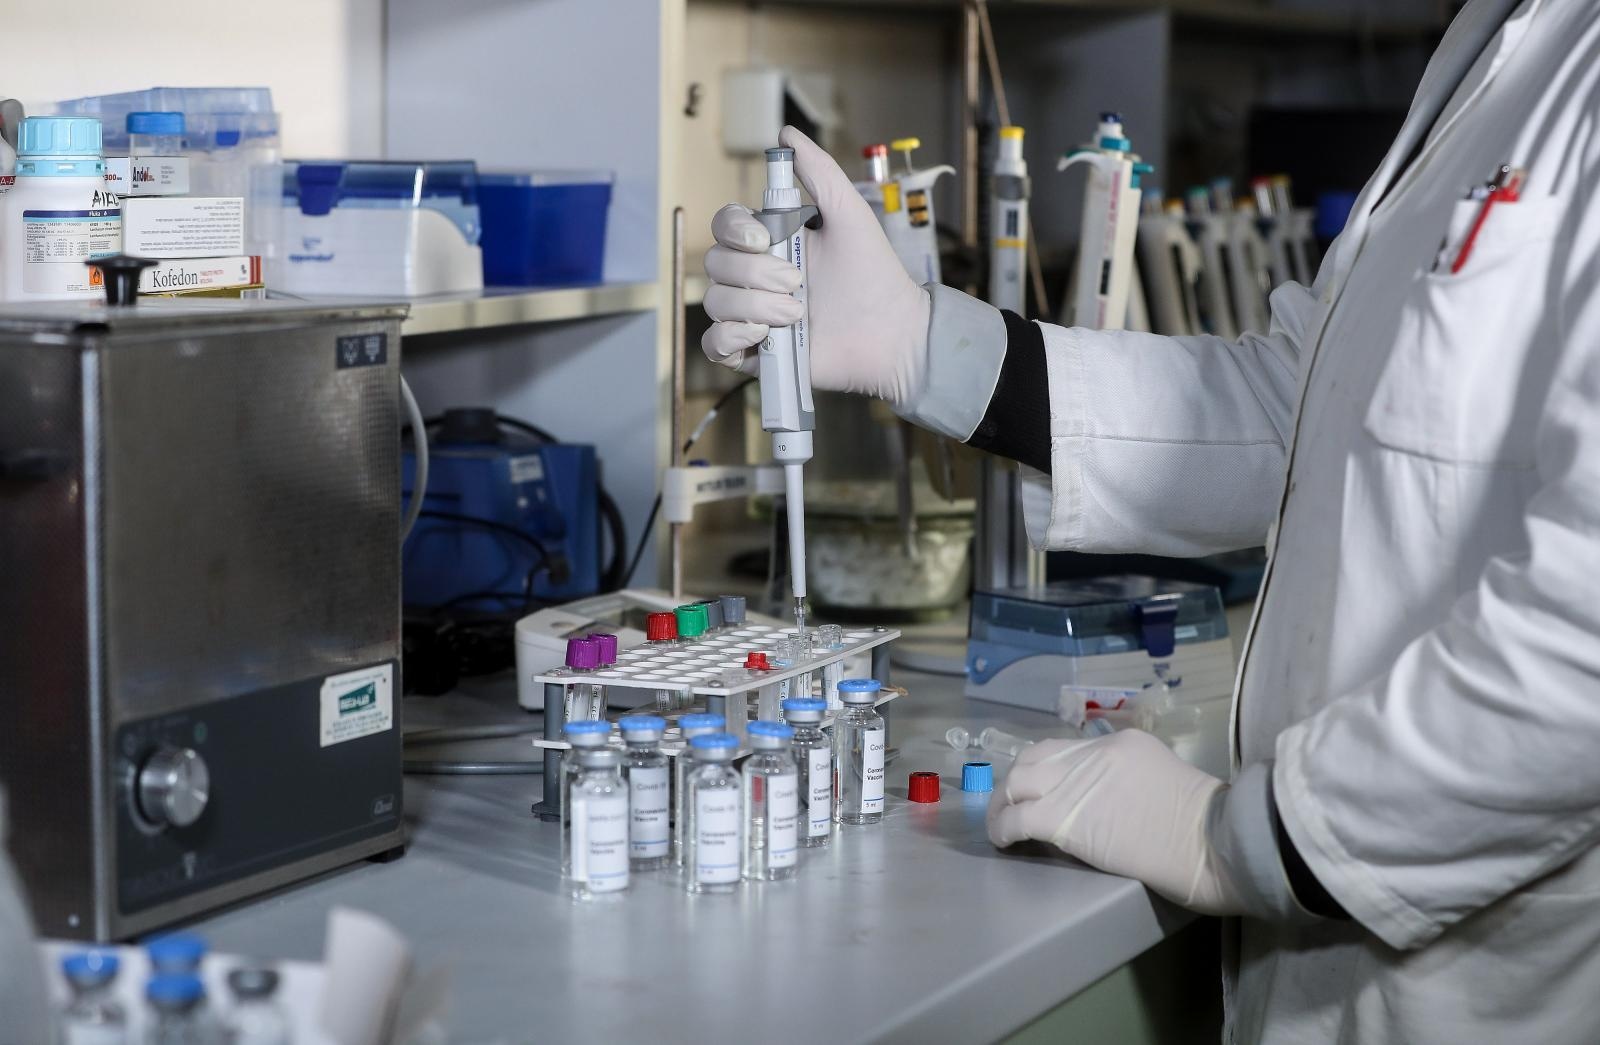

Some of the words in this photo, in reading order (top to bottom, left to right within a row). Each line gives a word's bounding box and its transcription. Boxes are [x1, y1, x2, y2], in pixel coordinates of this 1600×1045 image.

[794, 236, 803, 270] eppen
[153, 268, 198, 287] Kofedon
[778, 444, 786, 452] 10
